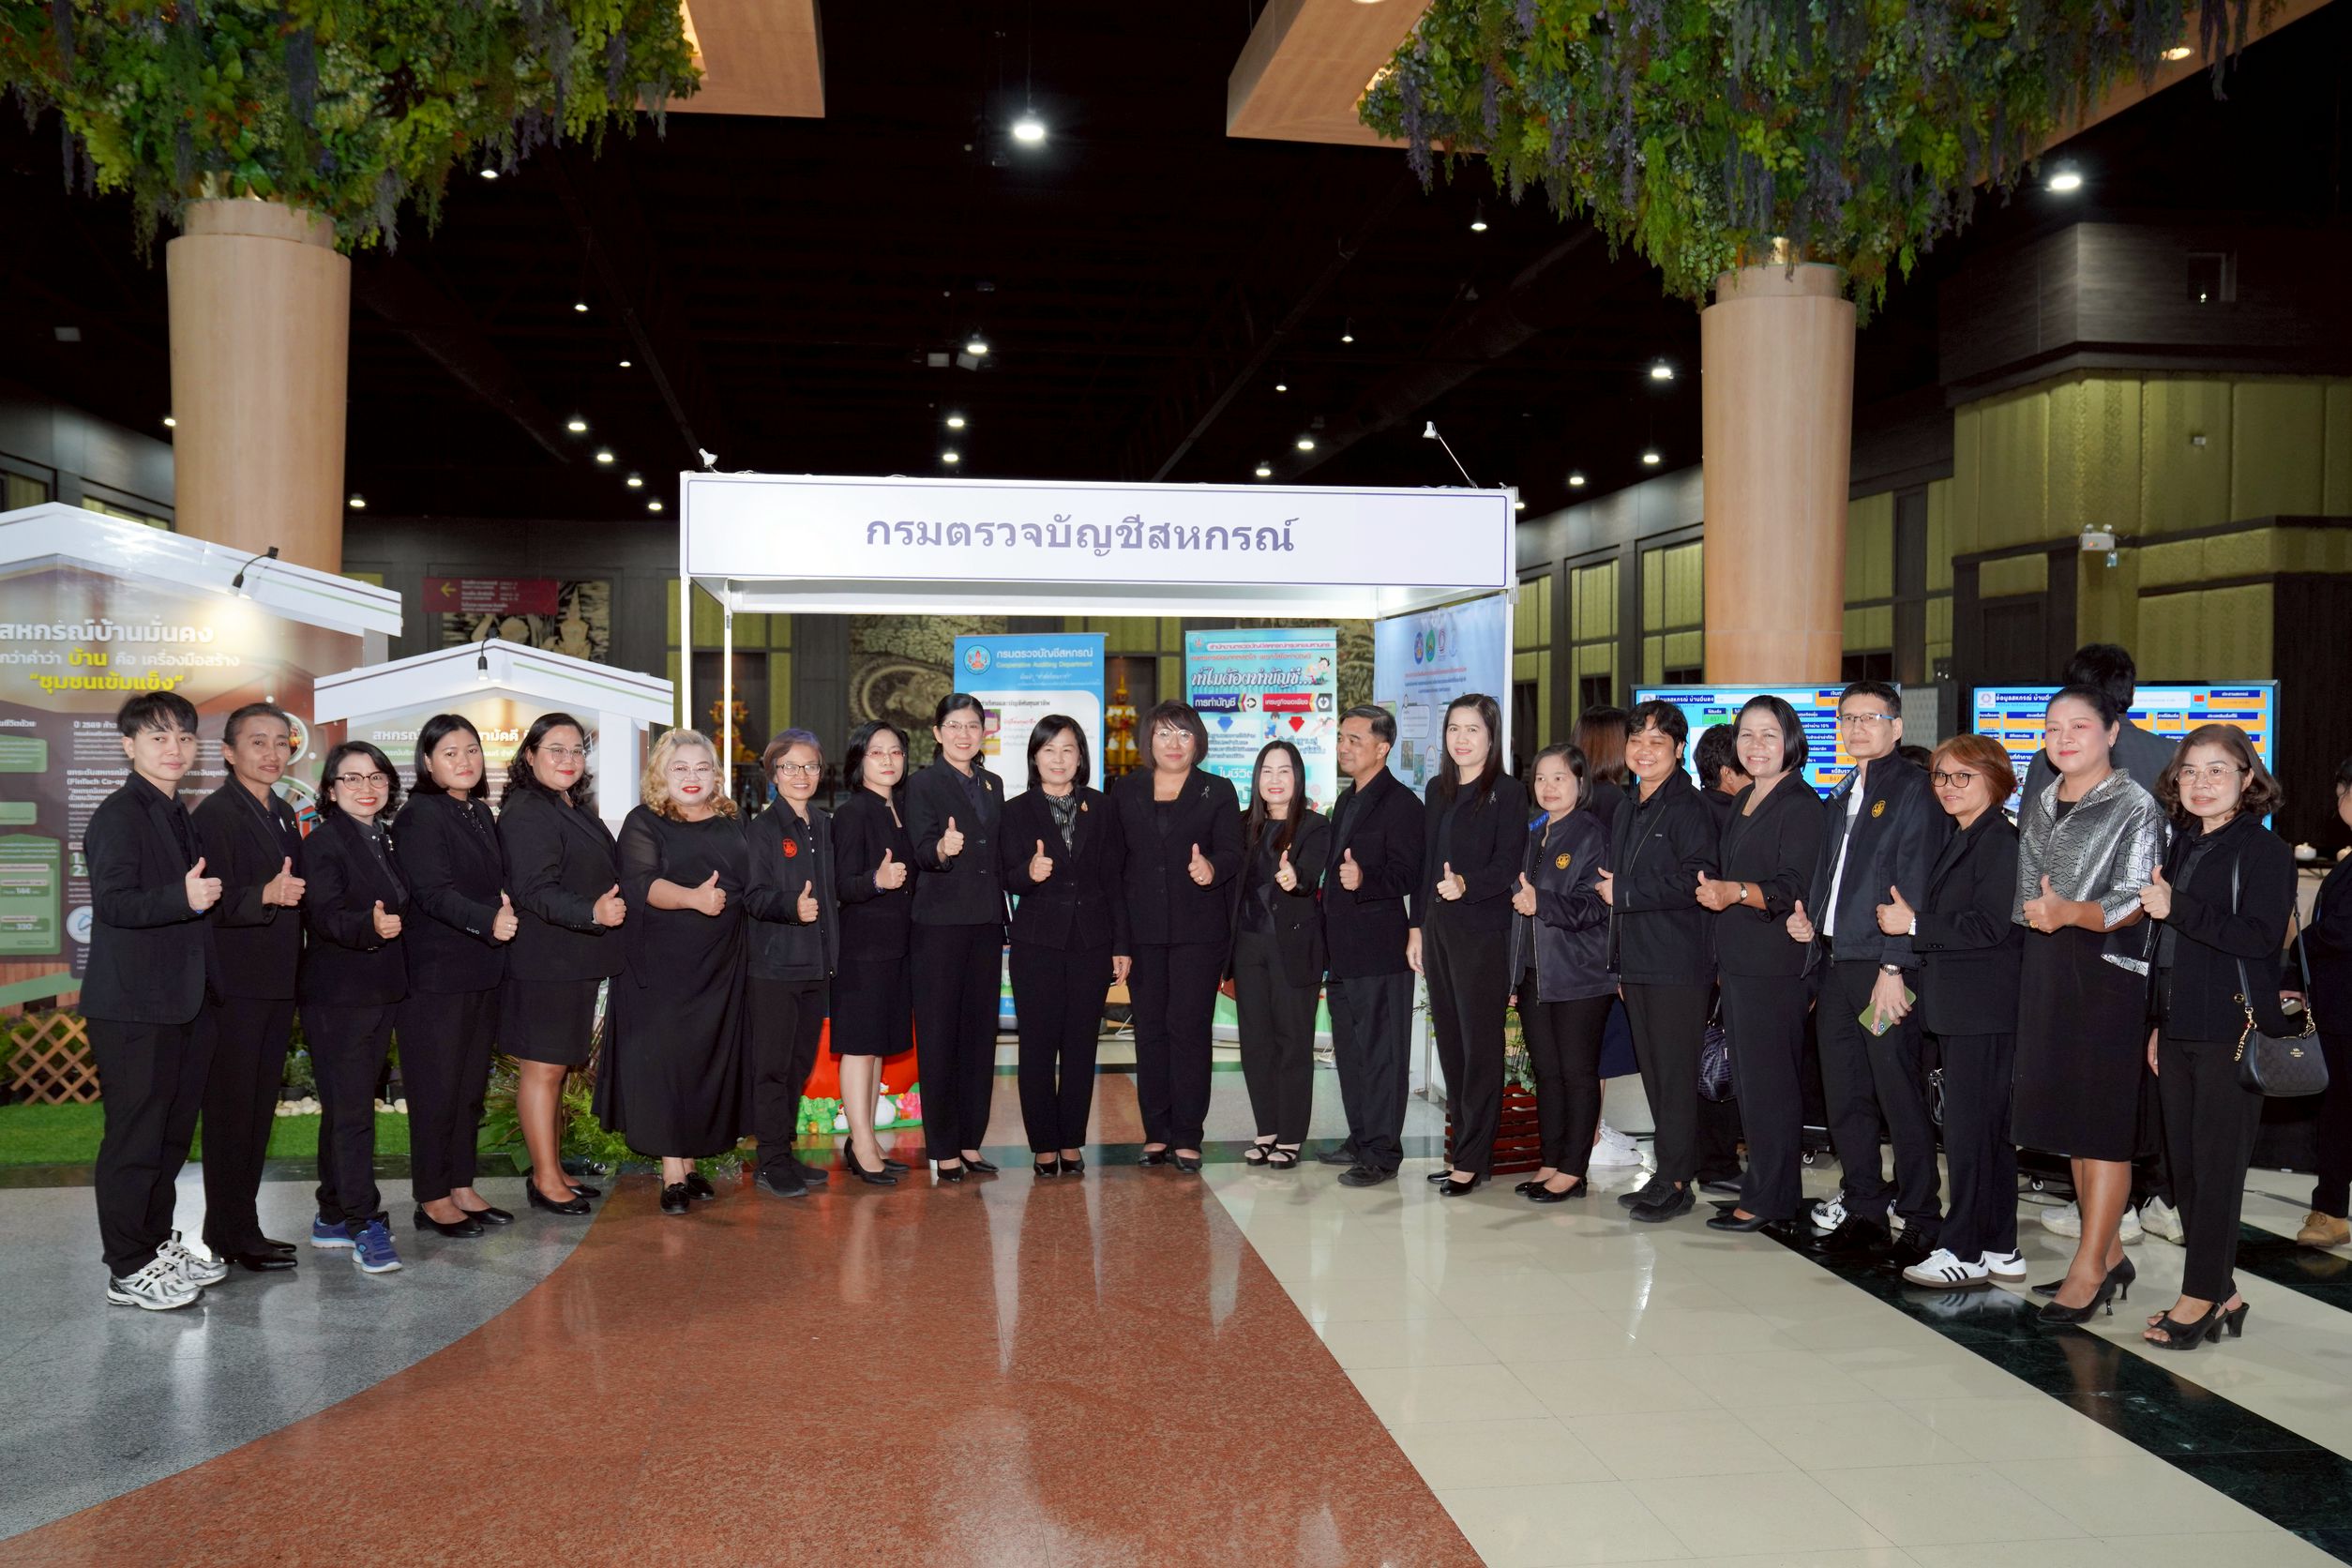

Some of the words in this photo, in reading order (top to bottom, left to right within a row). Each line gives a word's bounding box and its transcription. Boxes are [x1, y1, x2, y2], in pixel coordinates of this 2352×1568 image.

[866, 514, 1300, 556] กรมตรวจบัญชีสหกรณ์
[0, 615, 214, 643] สหกรณ์บ้านมั่นคง
[68, 647, 108, 667] บ้าน
[115, 650, 136, 665] คือ
[142, 649, 241, 668] เครื่องมือสร้าง
[996, 647, 1093, 659] กรมตรวจบัญชีสหกรณ์
[1192, 667, 1313, 689] ทำไมต้องทำบัญชี...
[1195, 697, 1236, 708] การทำบัญชี
